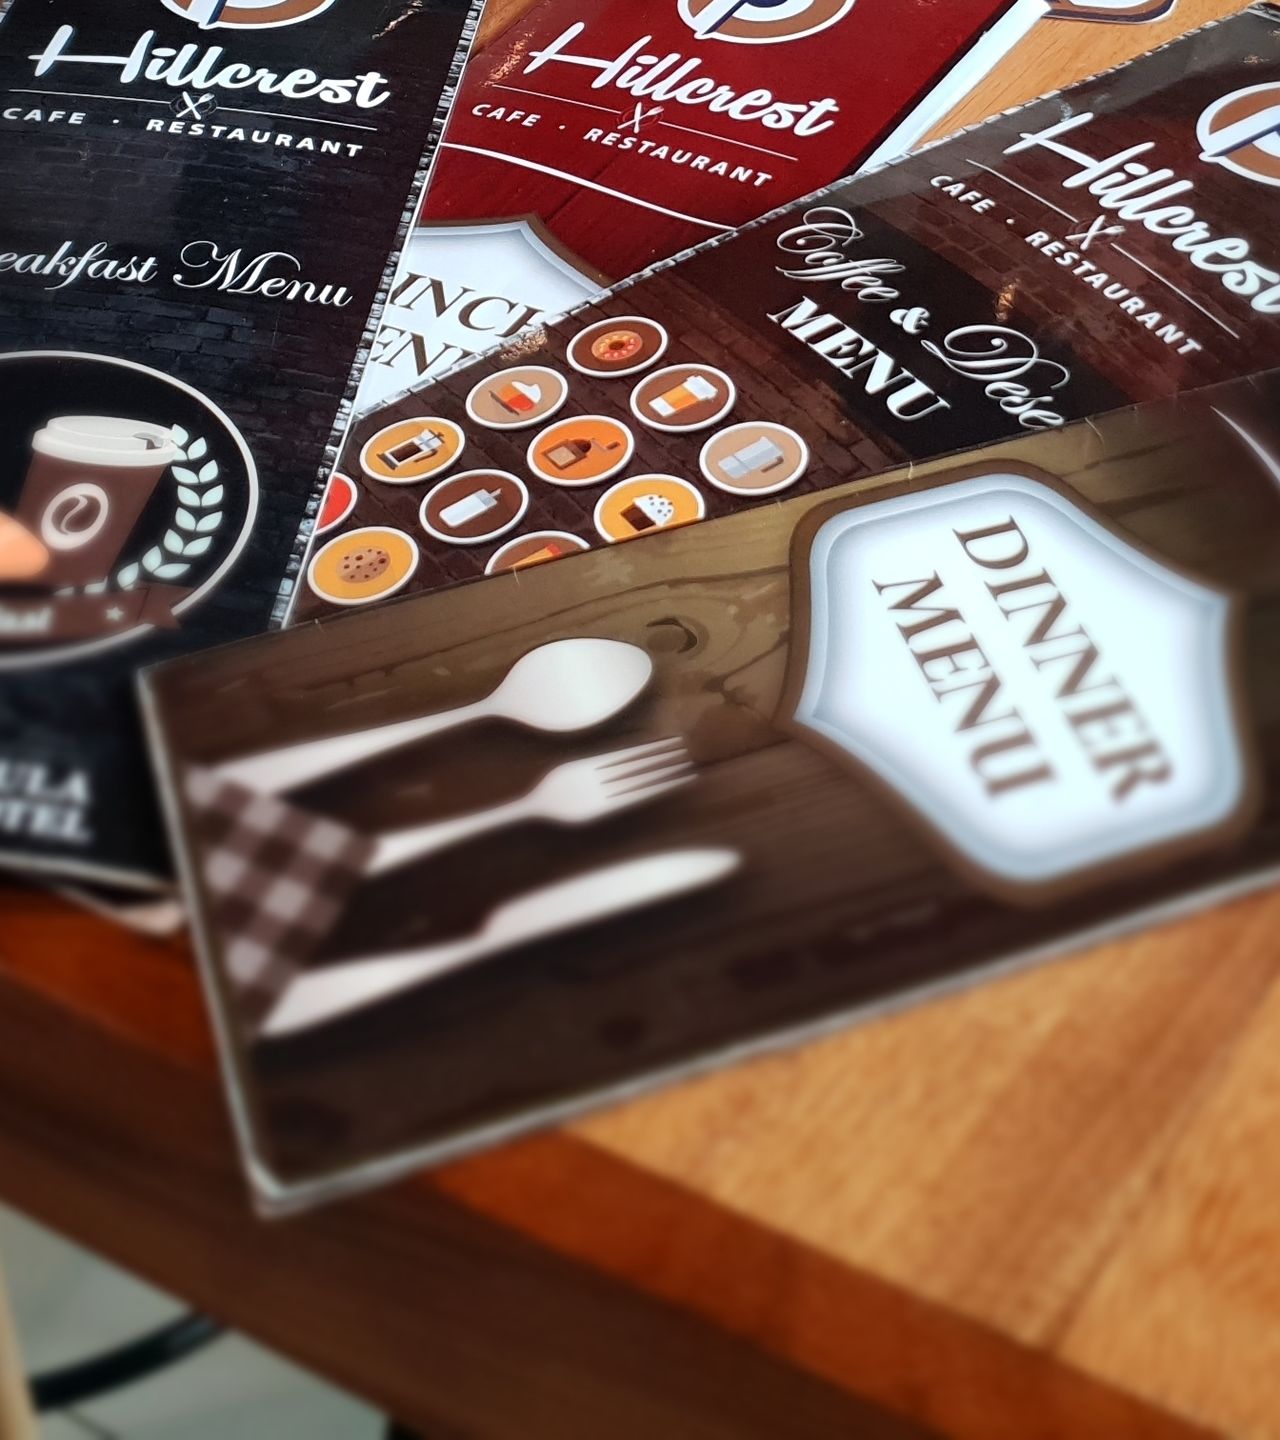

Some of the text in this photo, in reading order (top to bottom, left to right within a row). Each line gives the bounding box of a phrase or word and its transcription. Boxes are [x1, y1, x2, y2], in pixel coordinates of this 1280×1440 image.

[28, 24, 390, 109] Hillcrest
[522, 21, 841, 138] Hillcrest
[2, 106, 365, 159] CAFE RESTAURANT
[471, 102, 773, 188] CAFE RESTAURANT
[172, 240, 354, 309] Menu
[774, 205, 907, 305] Coffee
[890, 303, 930, 337] &
[929, 173, 1204, 360] CAFE RESTAURANT
[766, 294, 951, 425] MENU
[870, 568, 1059, 801] MENU
[951, 513, 1175, 805] DINNER
